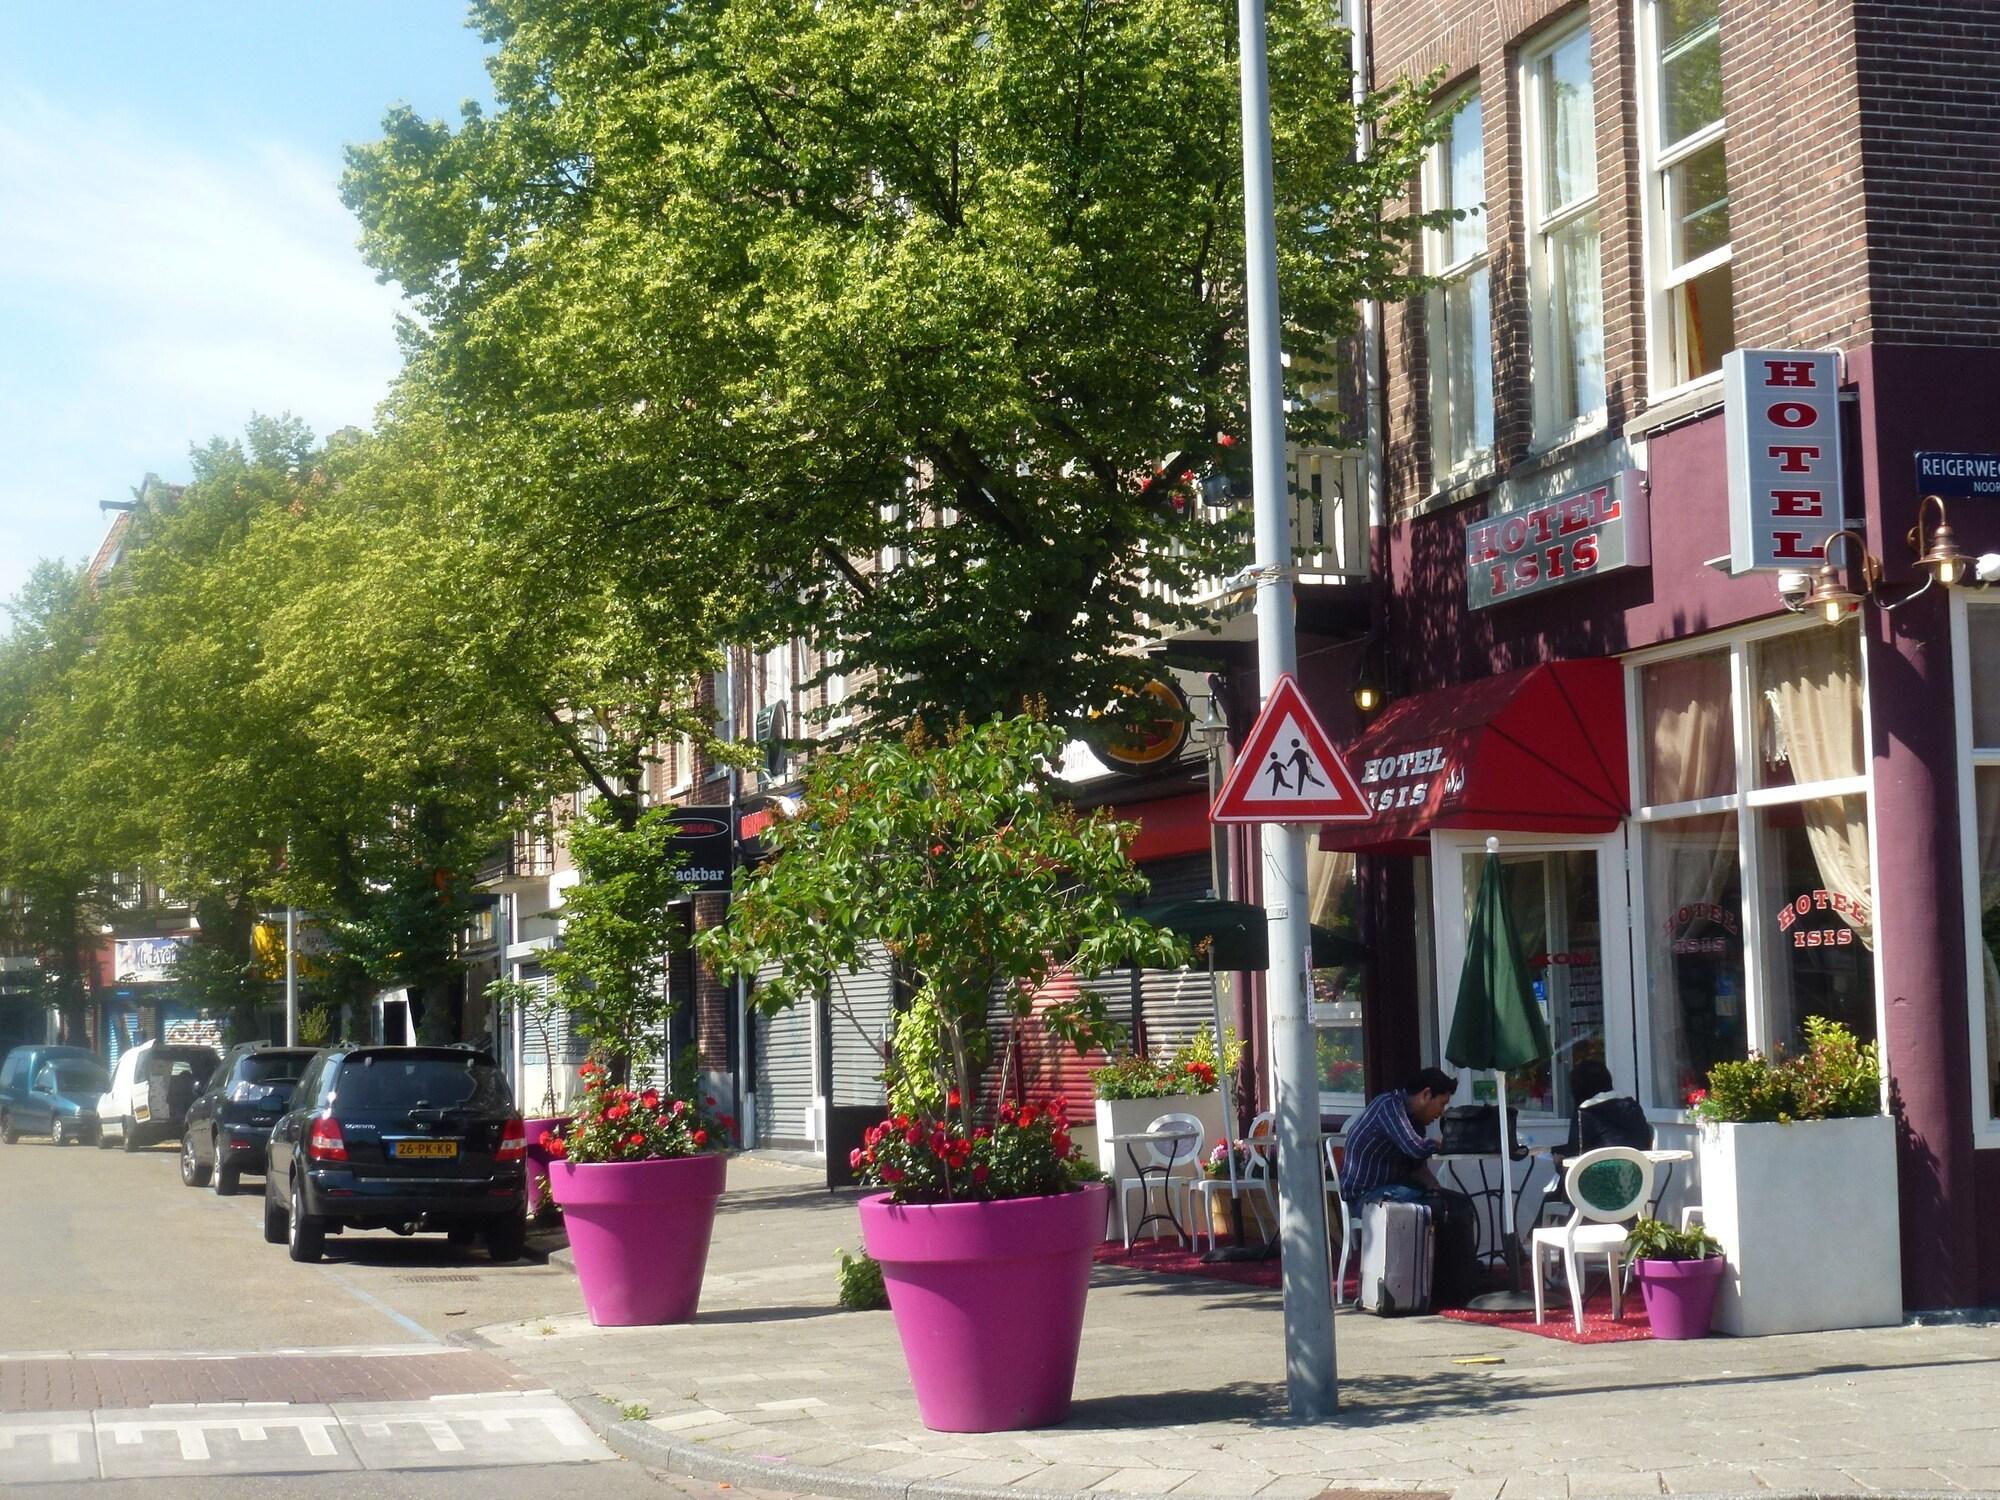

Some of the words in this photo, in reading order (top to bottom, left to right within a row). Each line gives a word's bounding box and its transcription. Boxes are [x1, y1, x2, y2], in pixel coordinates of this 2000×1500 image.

[1764, 360, 1826, 560] HOTEL
[1922, 458, 2000, 477] REIGERWE
[1470, 486, 1622, 566] HOTEL
[1490, 533, 1600, 597] ISIS
[1361, 746, 1446, 784] HOTEL
[674, 866, 724, 881] ackbar
[1665, 902, 1737, 936] HOTEL
[1777, 889, 1865, 932] HOTEL
[1794, 929, 1851, 947] ISIS
[399, 1143, 453, 1155] 26-PK-KR
